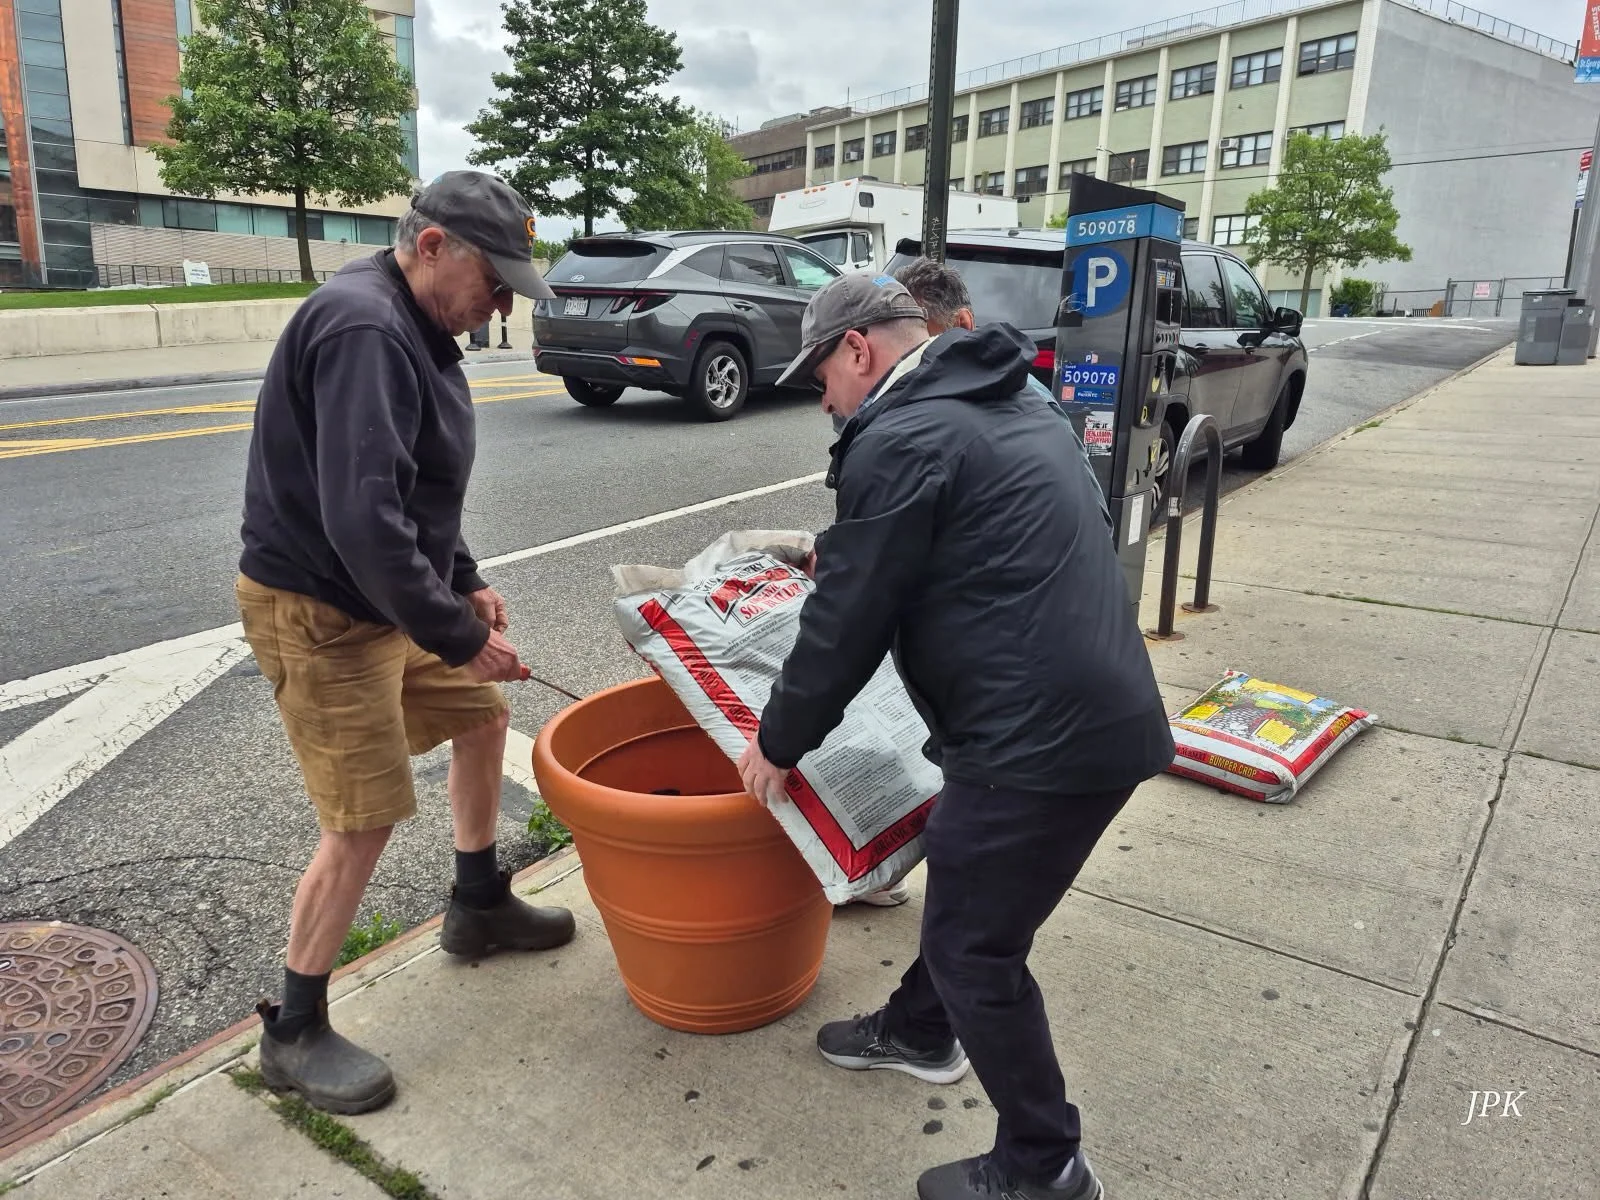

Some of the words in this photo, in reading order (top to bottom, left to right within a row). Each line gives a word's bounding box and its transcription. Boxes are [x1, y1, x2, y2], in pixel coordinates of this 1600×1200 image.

[1078, 219, 1136, 237] 509078
[1086, 256, 1118, 308] P
[1064, 370, 1116, 385] 509078
[1209, 754, 1238, 773] BUMPER
[1239, 764, 1257, 778] CROP
